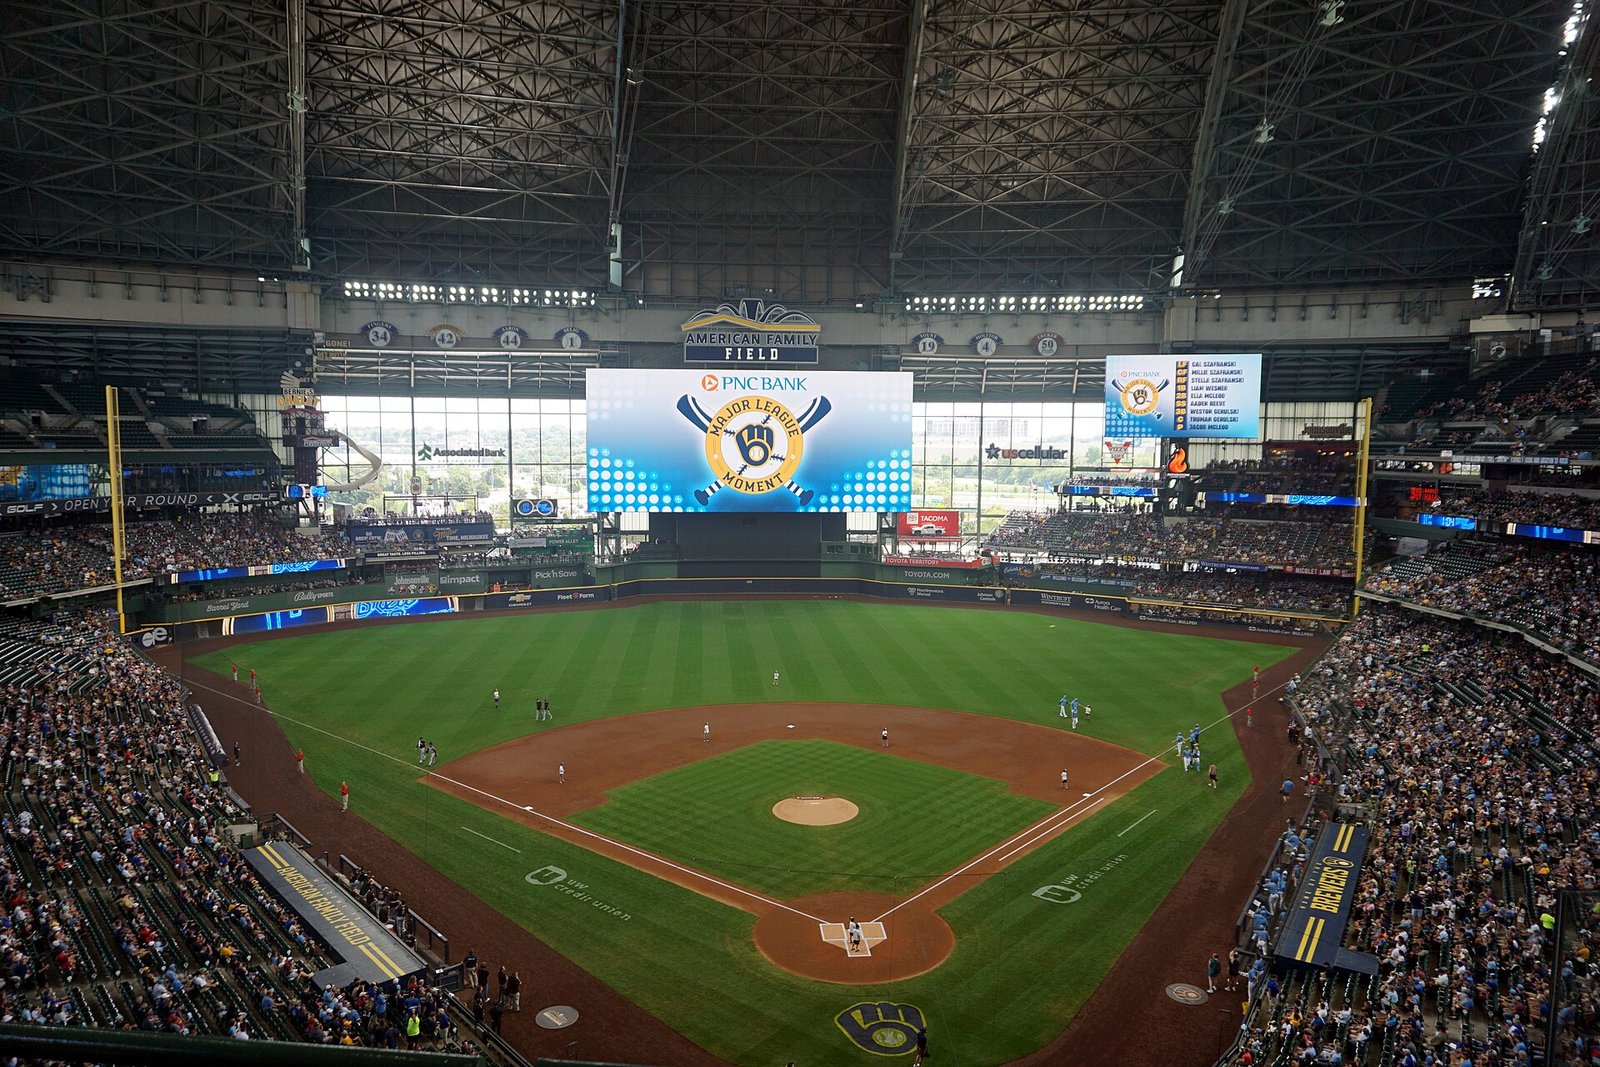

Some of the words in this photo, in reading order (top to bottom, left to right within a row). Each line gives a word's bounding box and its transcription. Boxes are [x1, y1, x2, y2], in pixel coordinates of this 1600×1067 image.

[371, 331, 388, 342] 34
[438, 333, 454, 344] 42
[502, 335, 518, 346] 44
[569, 337, 575, 347] 1
[686, 333, 760, 345] AMERICAN
[766, 333, 818, 346] FAMILY
[921, 342, 935, 350] 19
[982, 342, 989, 352] 4
[1041, 340, 1054, 348] 50
[725, 348, 778, 360] FIELD
[721, 376, 758, 390] PNC
[762, 377, 807, 391] BANK
[709, 399, 751, 437] MAJOR
[756, 399, 799, 438] LEAGUE
[433, 447, 484, 457] Associated
[485, 447, 506, 457] Bank
[722, 471, 784, 492] MOMENT
[7, 504, 44, 513] GOLF
[64, 498, 99, 511] OPEN
[145, 494, 198, 505] ROUND
[222, 493, 240, 502] X
[243, 493, 278, 501] GOLF
[559, 570, 577, 578] Save
[904, 571, 950, 579] TOYOTA.COM
[1295, 567, 1318, 575] NICOLET
[1319, 568, 1331, 576] LAW
[447, 574, 480, 584] impact
[293, 591, 317, 601] Bally
[1041, 593, 1071, 602] WINTRUST
[206, 603, 230, 612] Barrel
[230, 601, 249, 611] Yard
[1310, 867, 1349, 914] BREWERS
[277, 866, 321, 907] AMERICAN
[313, 897, 349, 930] FAMILY
[338, 921, 371, 947] FIELD
[554, 883, 592, 902] credit
[592, 900, 632, 921] union
